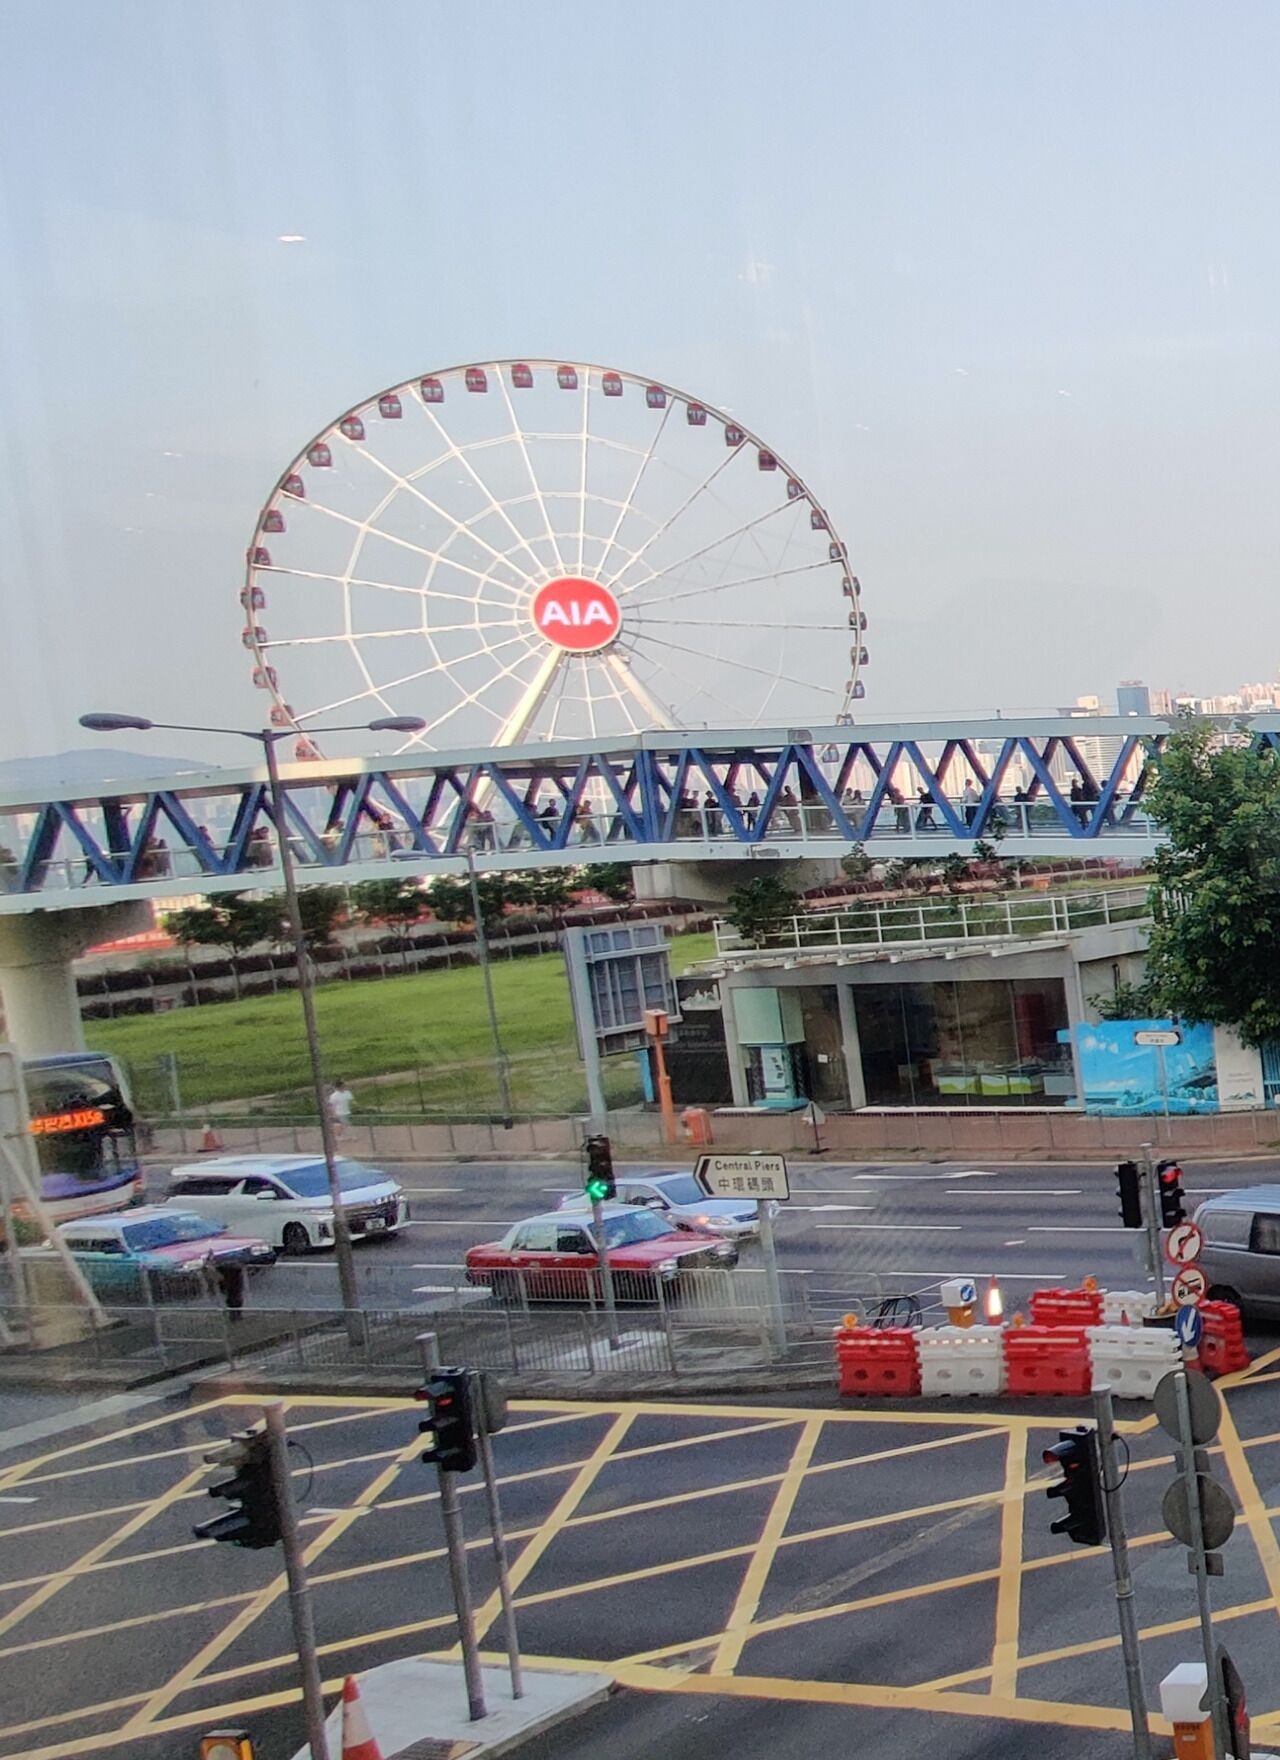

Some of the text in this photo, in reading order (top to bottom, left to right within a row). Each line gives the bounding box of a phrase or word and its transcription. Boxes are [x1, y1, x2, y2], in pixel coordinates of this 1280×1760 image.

[540, 600, 614, 626] AIA
[714, 1160, 781, 1172] Central Piers
[718, 1176, 775, 1193] 中環碼頭
